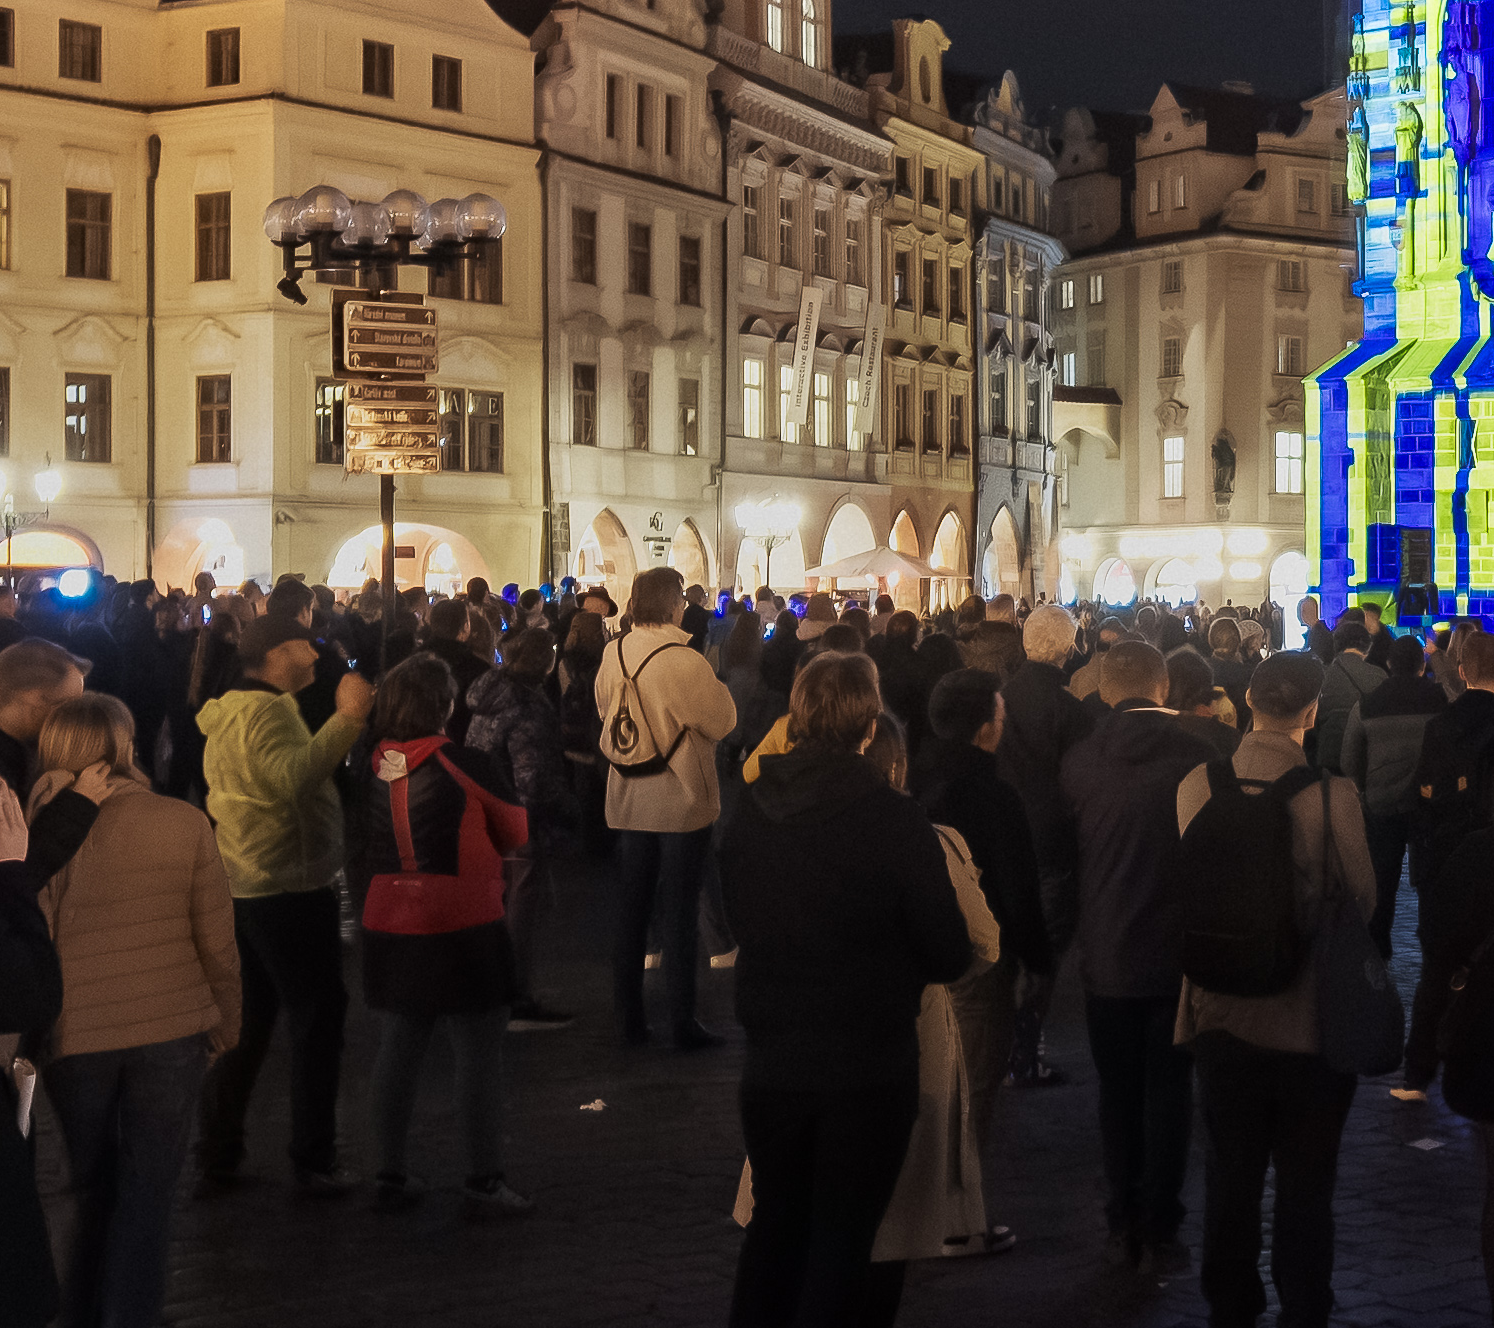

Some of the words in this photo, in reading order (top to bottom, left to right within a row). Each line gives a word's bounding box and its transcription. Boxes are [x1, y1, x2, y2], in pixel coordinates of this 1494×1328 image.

[795, 354, 807, 407] Interactive
[801, 301, 814, 352] Exhibition
[866, 326, 879, 378] Restaurant
